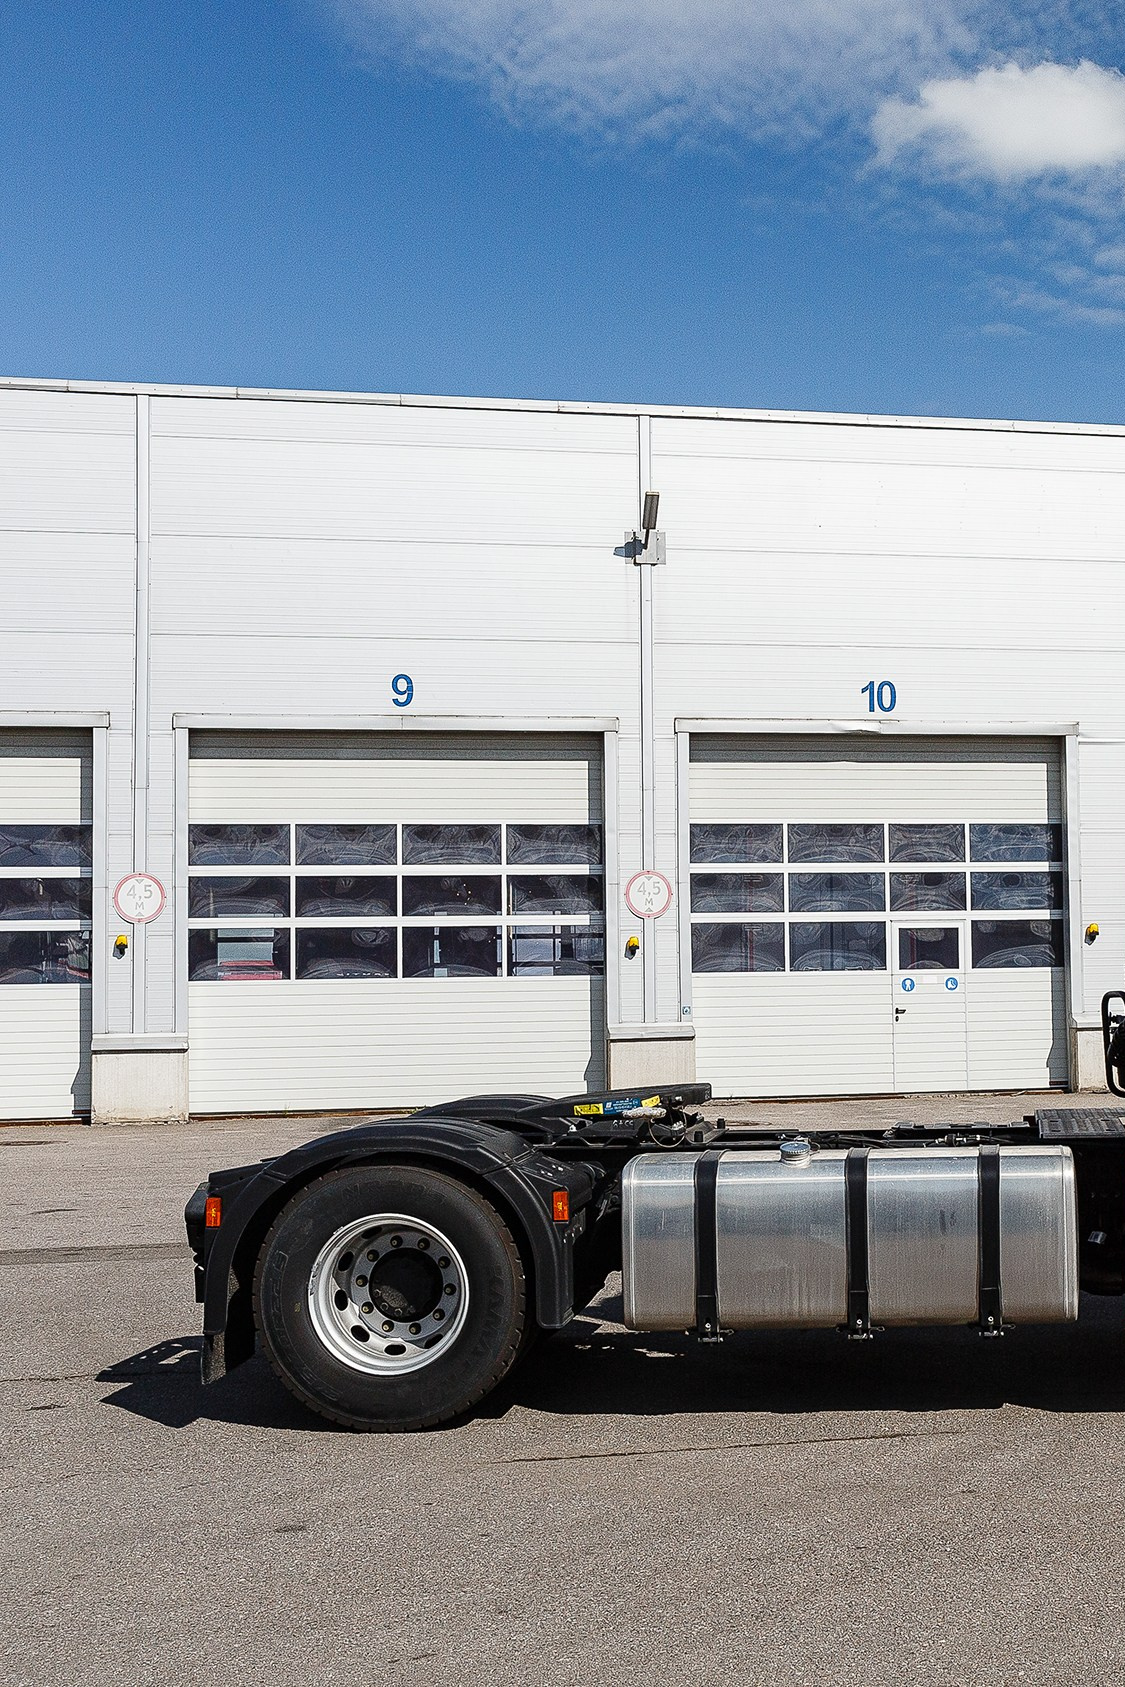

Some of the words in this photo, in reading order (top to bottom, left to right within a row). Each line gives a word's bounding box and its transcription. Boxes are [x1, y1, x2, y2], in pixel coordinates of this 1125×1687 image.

[392, 673, 413, 707] 9
[861, 680, 896, 712] 10
[127, 884, 152, 900] 4,5
[637, 881, 661, 897] 4,5
